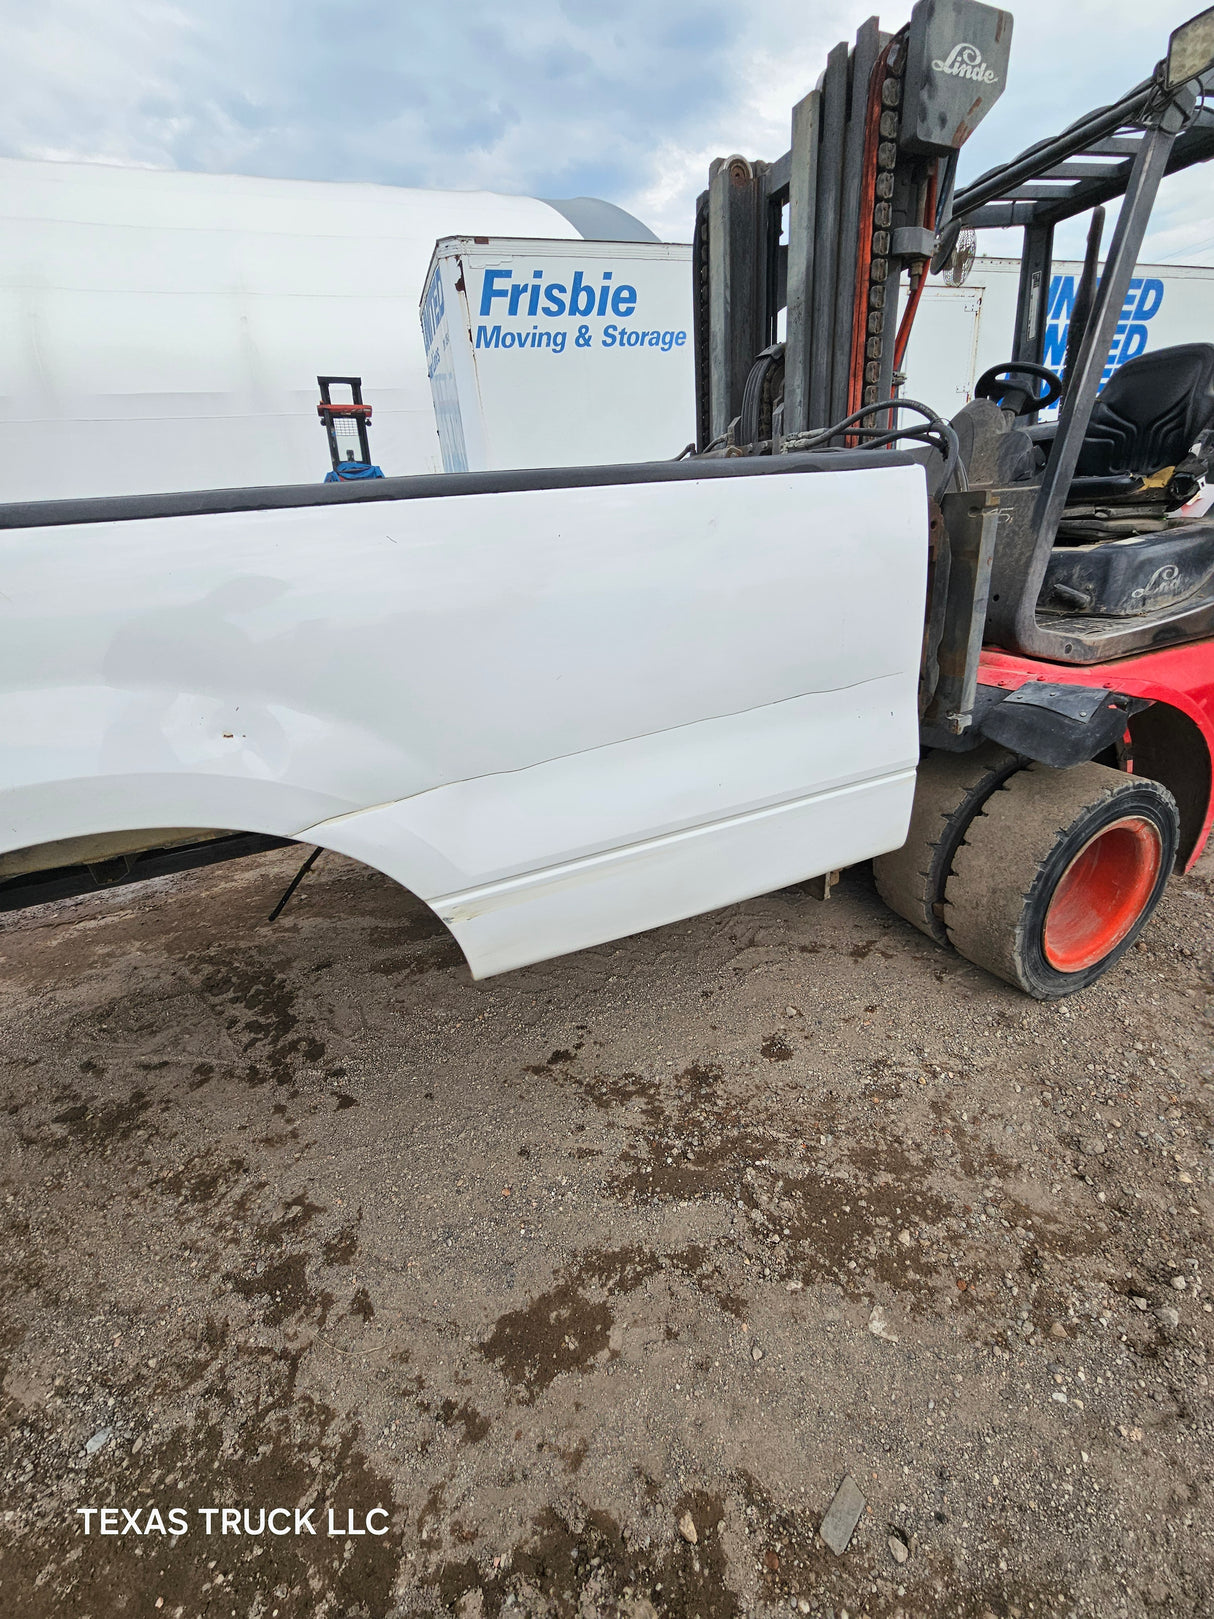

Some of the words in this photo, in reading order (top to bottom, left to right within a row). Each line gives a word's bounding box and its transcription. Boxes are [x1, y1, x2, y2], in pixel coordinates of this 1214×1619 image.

[931, 43, 999, 84] Linde
[479, 269, 637, 317] Frisbie
[475, 325, 567, 353] Moving
[574, 325, 592, 348] &
[601, 324, 687, 351] Storage
